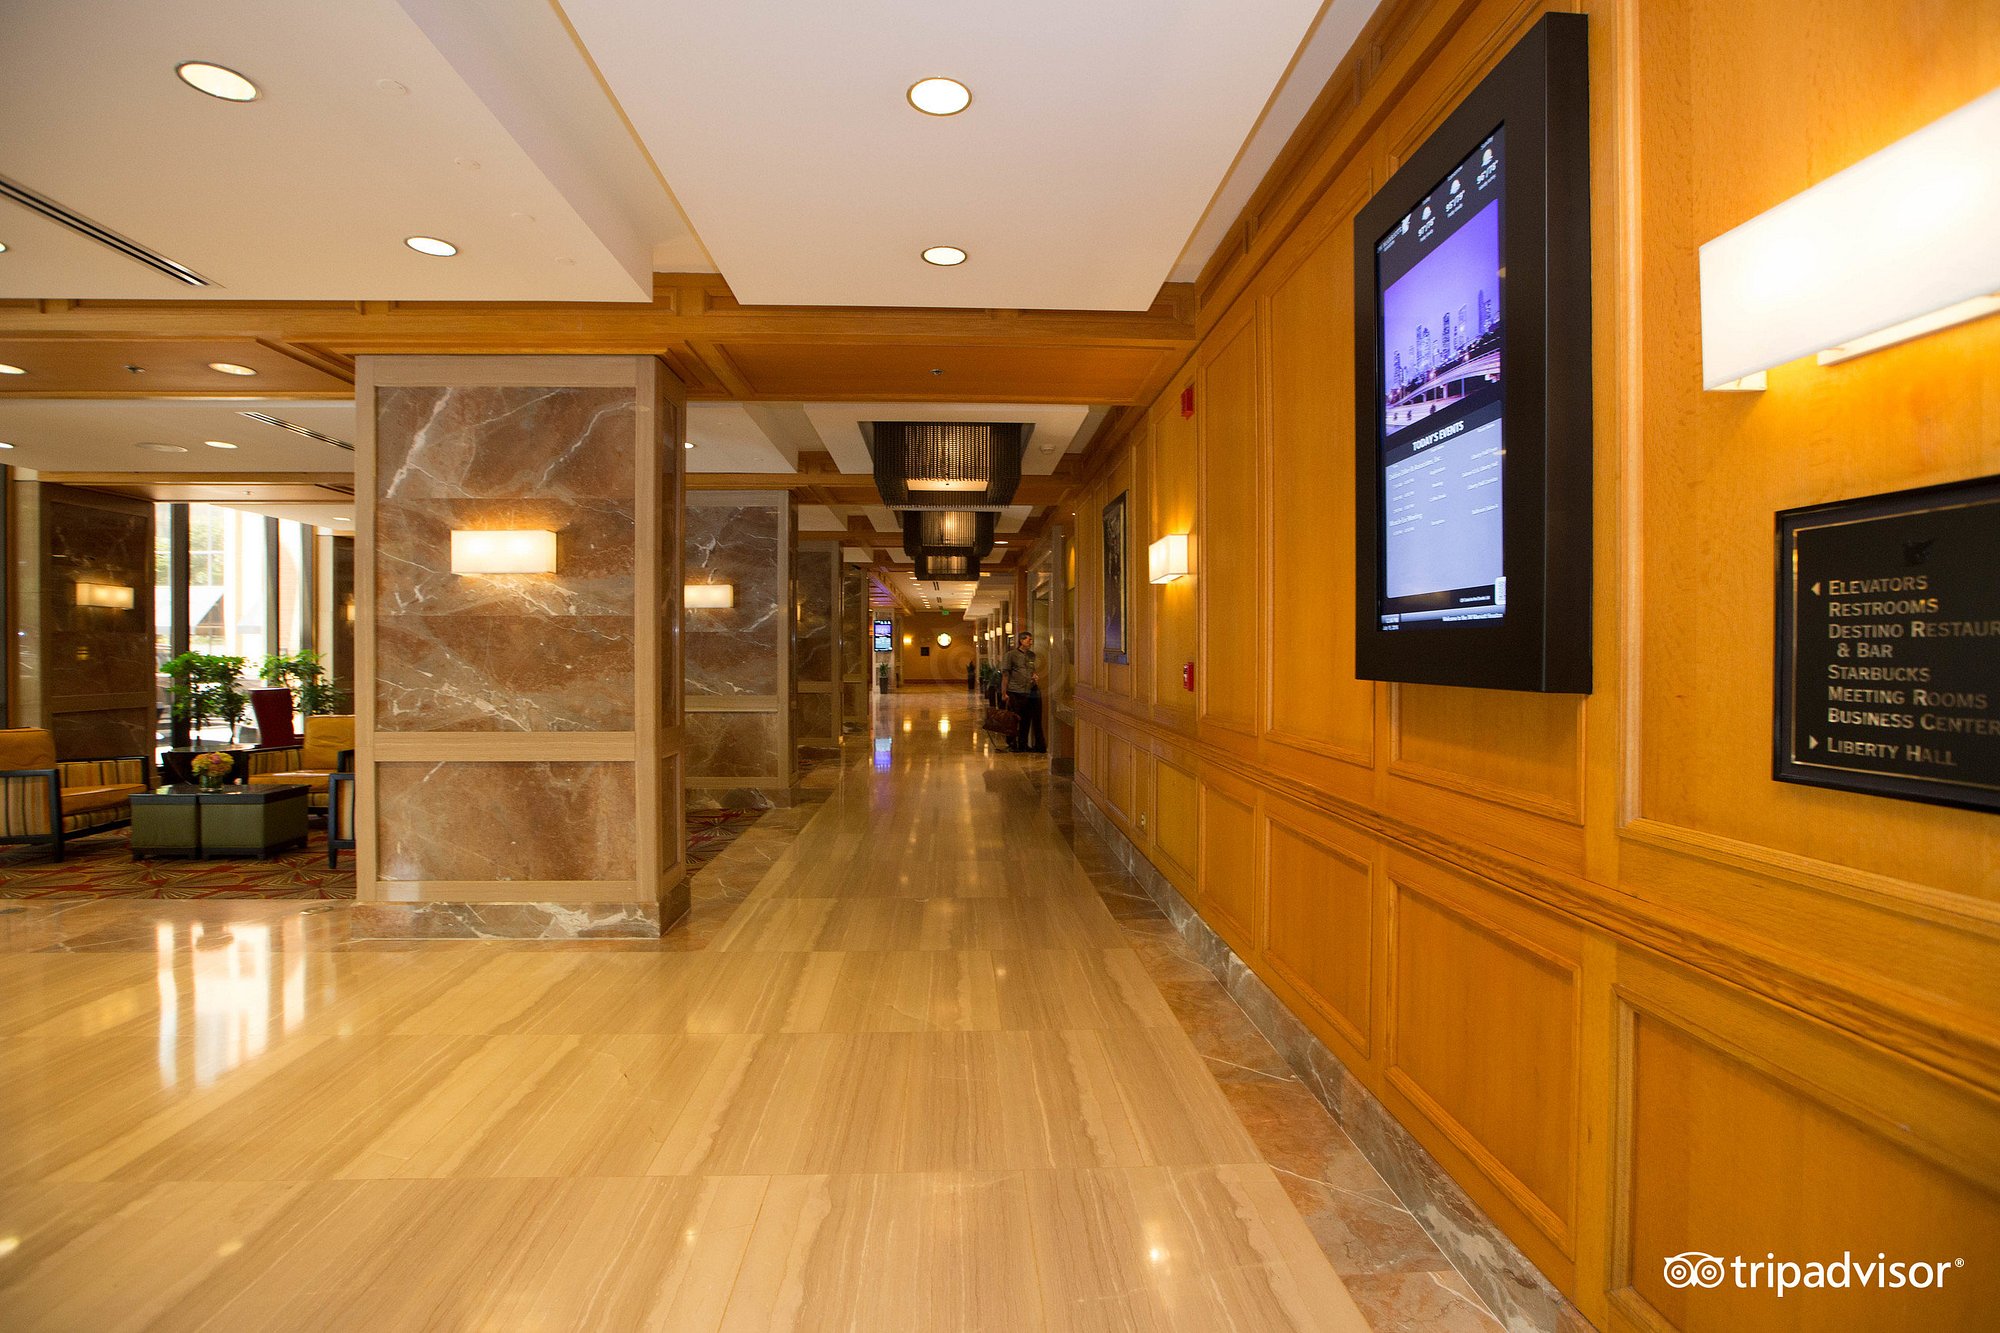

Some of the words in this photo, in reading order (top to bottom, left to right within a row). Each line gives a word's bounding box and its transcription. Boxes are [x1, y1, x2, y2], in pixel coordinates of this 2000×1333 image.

[1439, 420, 1464, 440] EVENTS
[1828, 575, 1929, 596] ELEVATORS
[1828, 598, 1939, 618] RESTROOMS
[1828, 623, 1904, 639] DESTINO
[1836, 642, 1850, 658] &
[1856, 642, 1894, 659] BAR
[1827, 664, 1931, 683] STARBUCKS
[1828, 686, 1905, 705] MEETING
[1912, 689, 1989, 710] ROOMS
[1828, 708, 1914, 729] BUSINESS
[1827, 737, 1900, 760] LIBERTY
[1906, 744, 1957, 766] HALL
